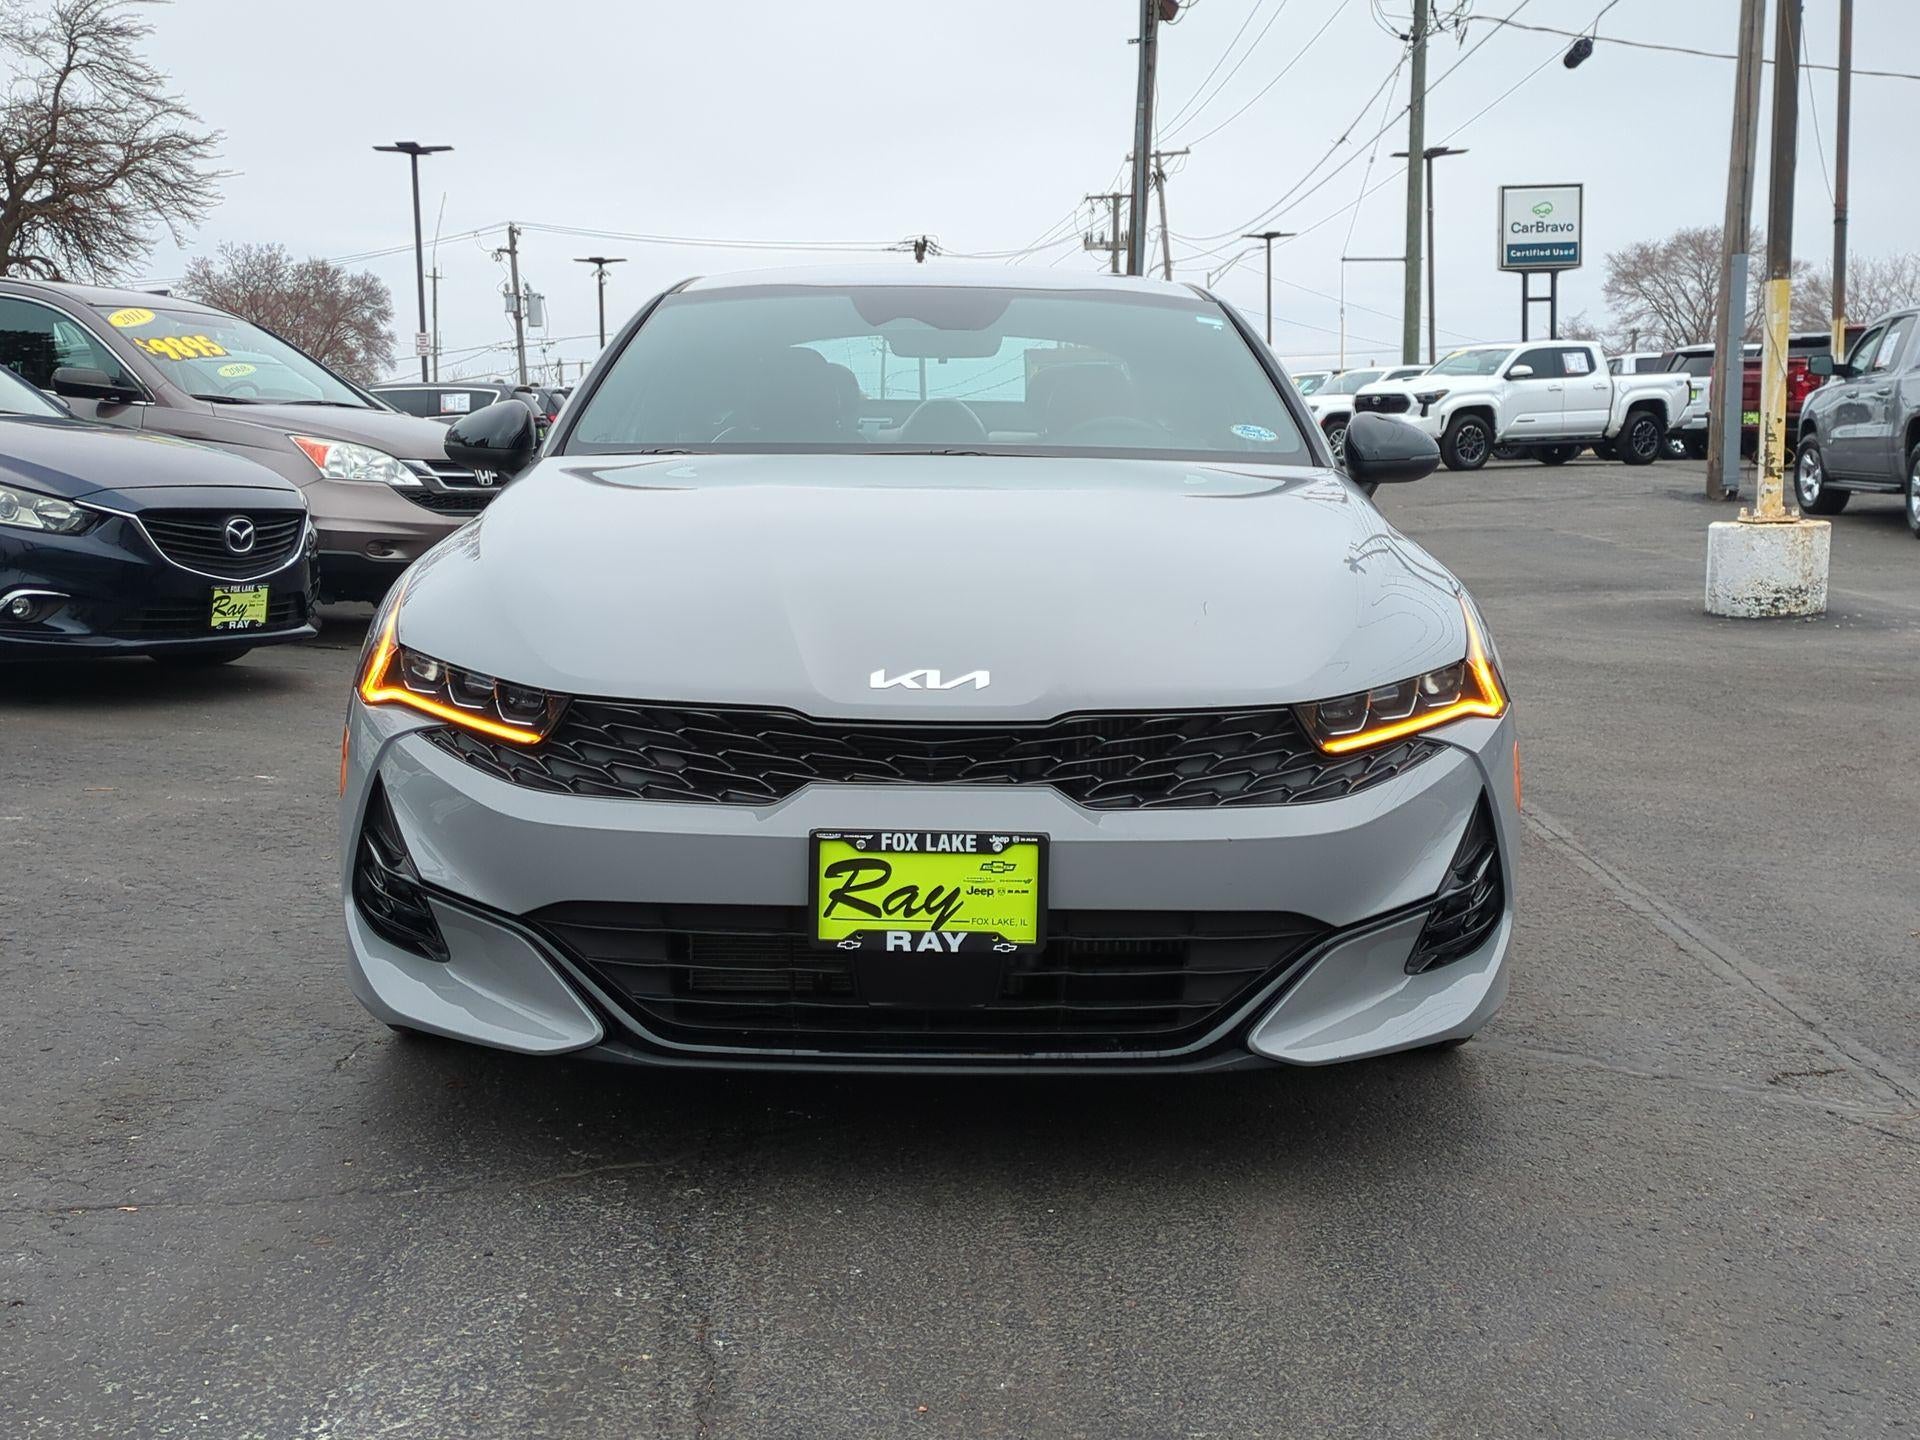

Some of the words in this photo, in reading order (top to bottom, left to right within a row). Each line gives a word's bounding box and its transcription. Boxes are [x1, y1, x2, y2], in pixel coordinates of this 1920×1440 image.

[1510, 221, 1575, 234] CarBravo
[1510, 248, 1551, 258] Certified
[1552, 247, 1575, 256] Used
[115, 310, 146, 325] 2011
[211, 594, 249, 621] Ray
[228, 620, 250, 629] RAY
[870, 668, 990, 690] KIA
[881, 833, 918, 852] FOX
[926, 834, 977, 853] LAKE
[989, 834, 1010, 845] Jeep
[822, 857, 965, 931] Ray
[966, 885, 995, 898] Jeep
[971, 917, 989, 927] FOX
[991, 917, 1018, 928] LAKE,
[1020, 918, 1029, 927] IL
[886, 931, 968, 952] RAY
